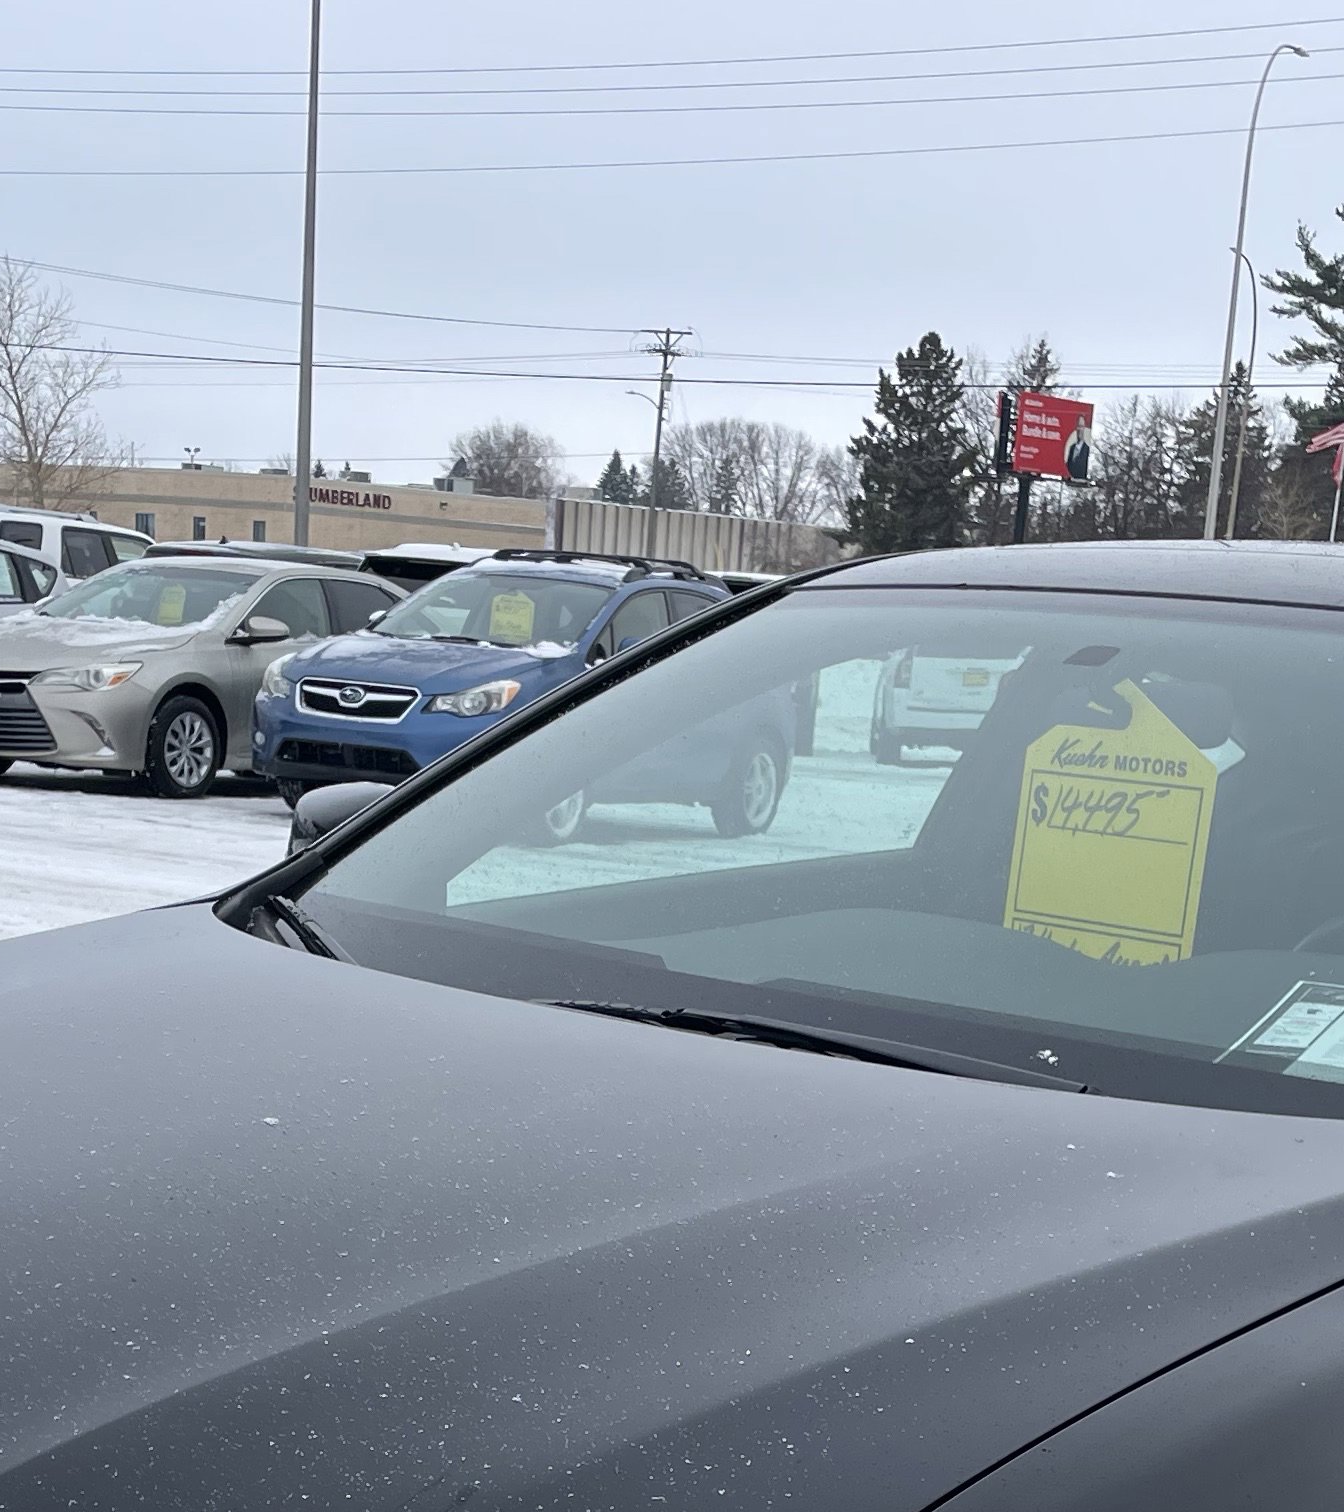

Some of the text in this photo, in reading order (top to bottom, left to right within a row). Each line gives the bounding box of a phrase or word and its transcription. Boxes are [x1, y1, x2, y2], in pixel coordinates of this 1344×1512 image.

[293, 486, 392, 510] UMBERLAND
[1050, 737, 1188, 778] Kuehn MOTORS
